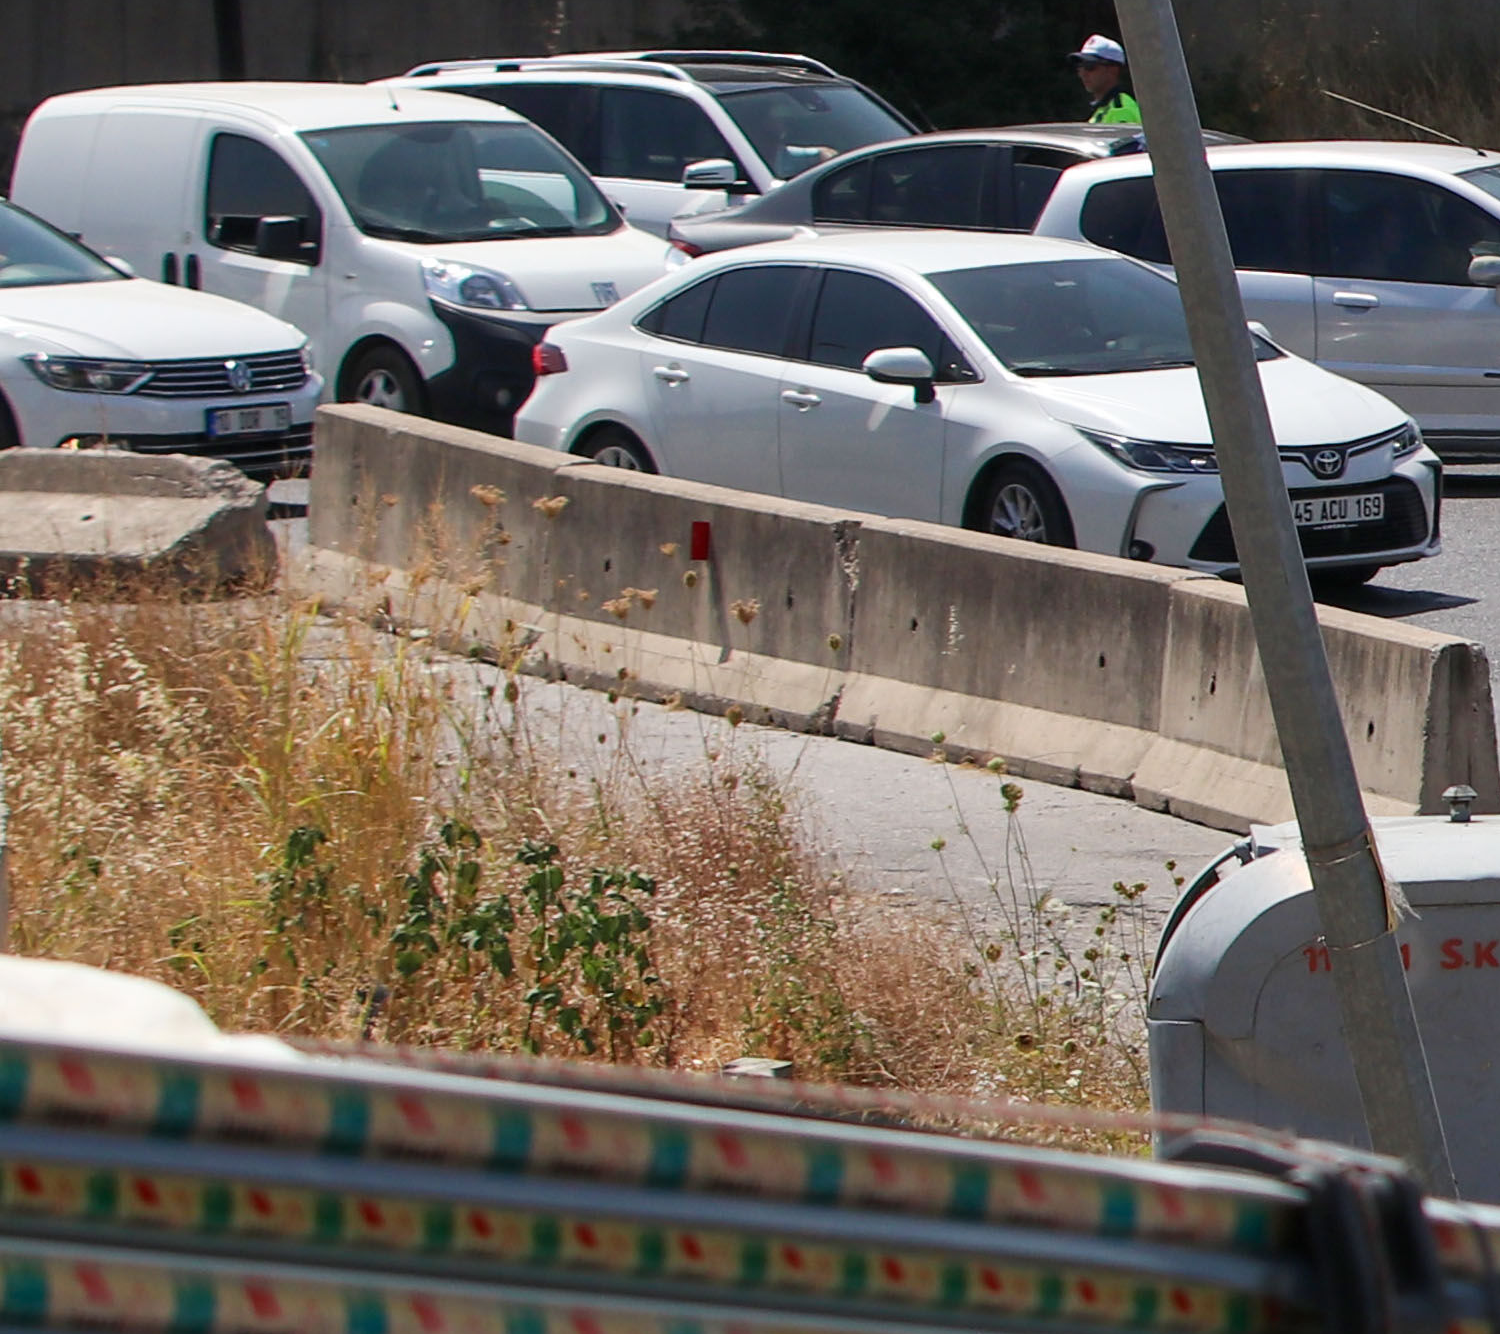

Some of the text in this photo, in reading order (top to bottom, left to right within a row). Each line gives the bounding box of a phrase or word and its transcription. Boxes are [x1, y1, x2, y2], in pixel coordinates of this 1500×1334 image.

[1294, 496, 1381, 523] 45 ACU 169
